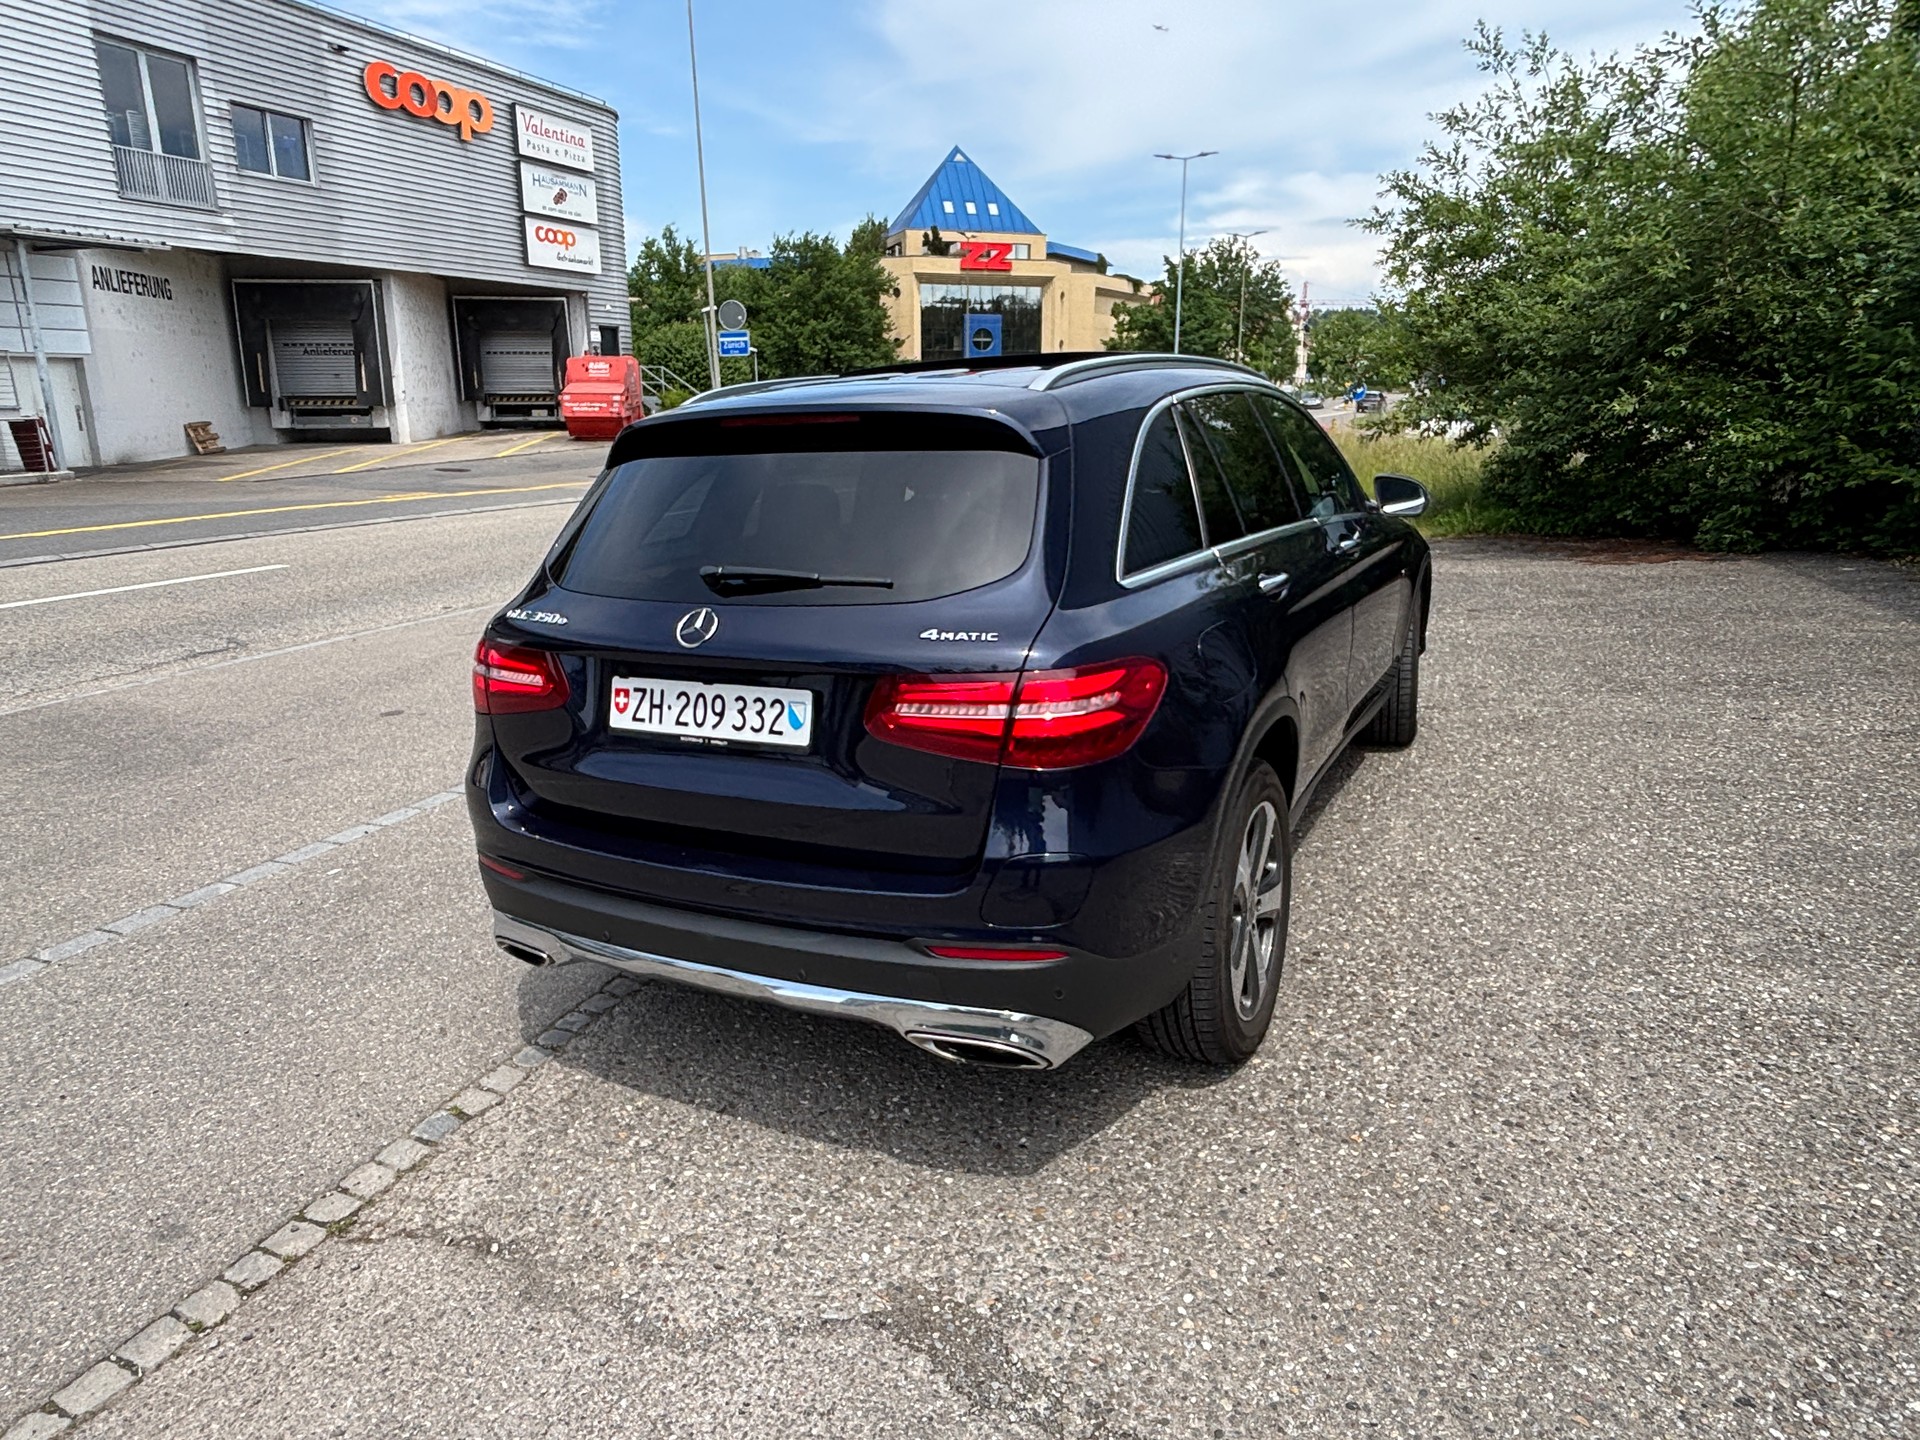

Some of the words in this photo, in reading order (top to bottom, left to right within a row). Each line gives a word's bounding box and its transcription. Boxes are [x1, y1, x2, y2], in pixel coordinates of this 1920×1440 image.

[363, 60, 494, 142] coop
[520, 111, 585, 148] Valentina
[526, 139, 550, 154] Pasta
[554, 149, 560, 157] e
[564, 149, 586, 163] Pizza
[535, 226, 577, 251] coop
[960, 242, 1013, 272] ZZ
[91, 264, 174, 301] ANLIEFERUNG
[302, 347, 356, 356] Anlieferun
[919, 628, 999, 641] 4MATIC
